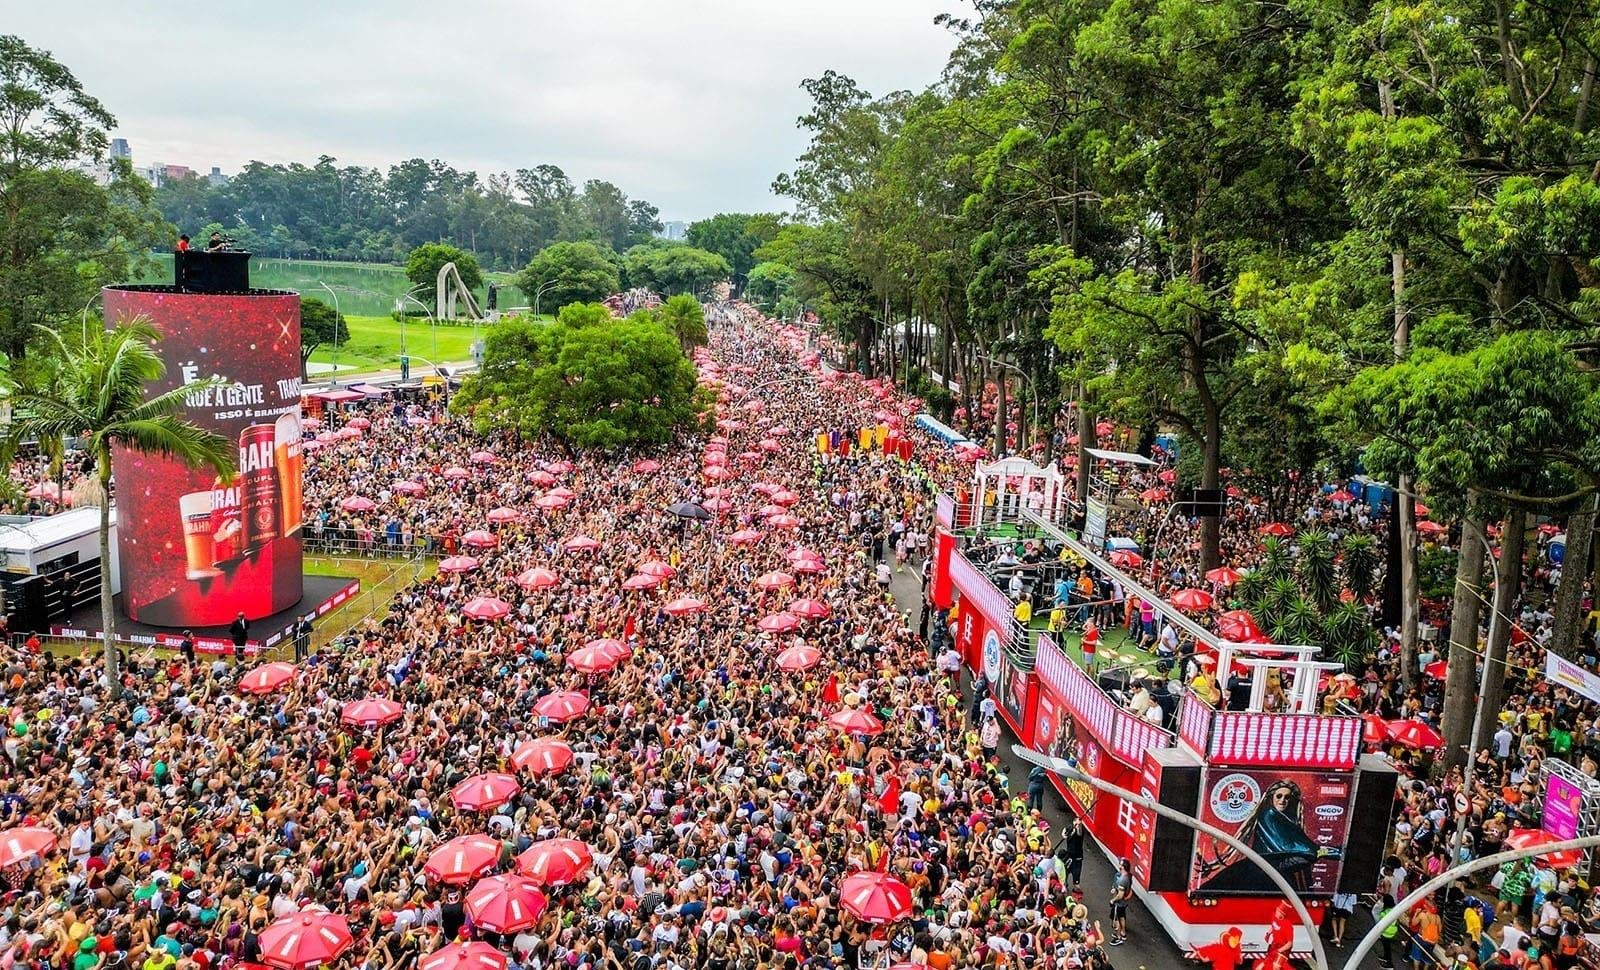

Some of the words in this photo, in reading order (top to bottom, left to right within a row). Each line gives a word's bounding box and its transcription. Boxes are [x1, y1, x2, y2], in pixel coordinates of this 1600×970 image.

[226, 384, 265, 407] GENTE
[214, 409, 243, 420] ISSO
[244, 407, 253, 417] É
[130, 634, 156, 645] BRAHMA
